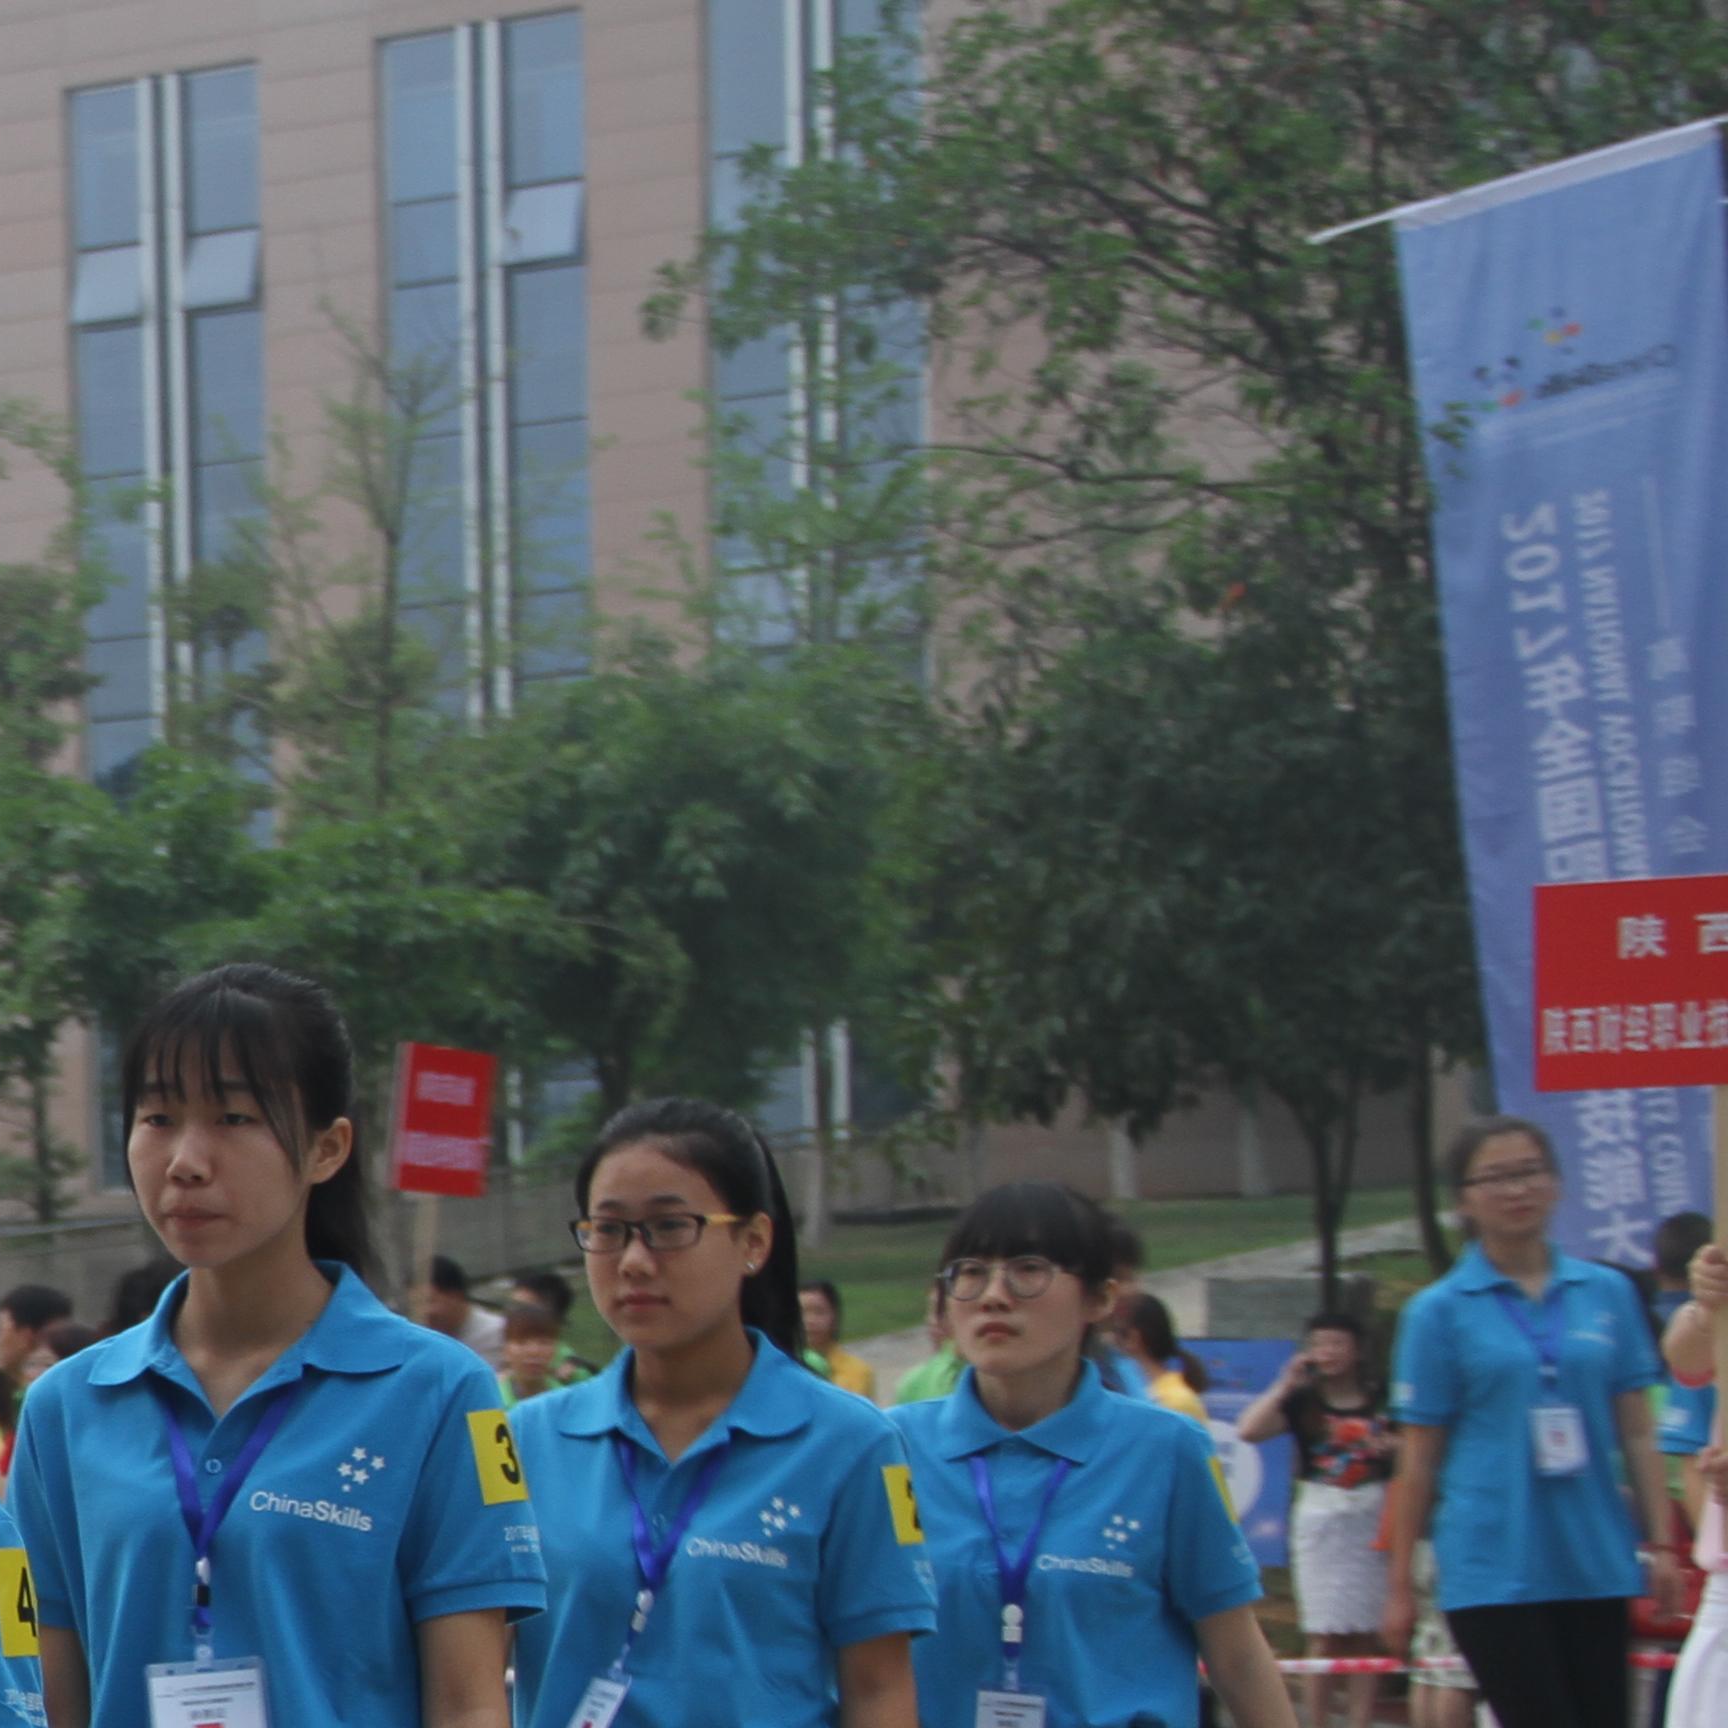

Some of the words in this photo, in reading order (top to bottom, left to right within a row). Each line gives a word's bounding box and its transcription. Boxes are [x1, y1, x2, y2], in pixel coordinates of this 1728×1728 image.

[494, 1423, 522, 1486] 3
[249, 1490, 373, 1532] ChinaSkills
[17, 1566, 37, 1638] 4
